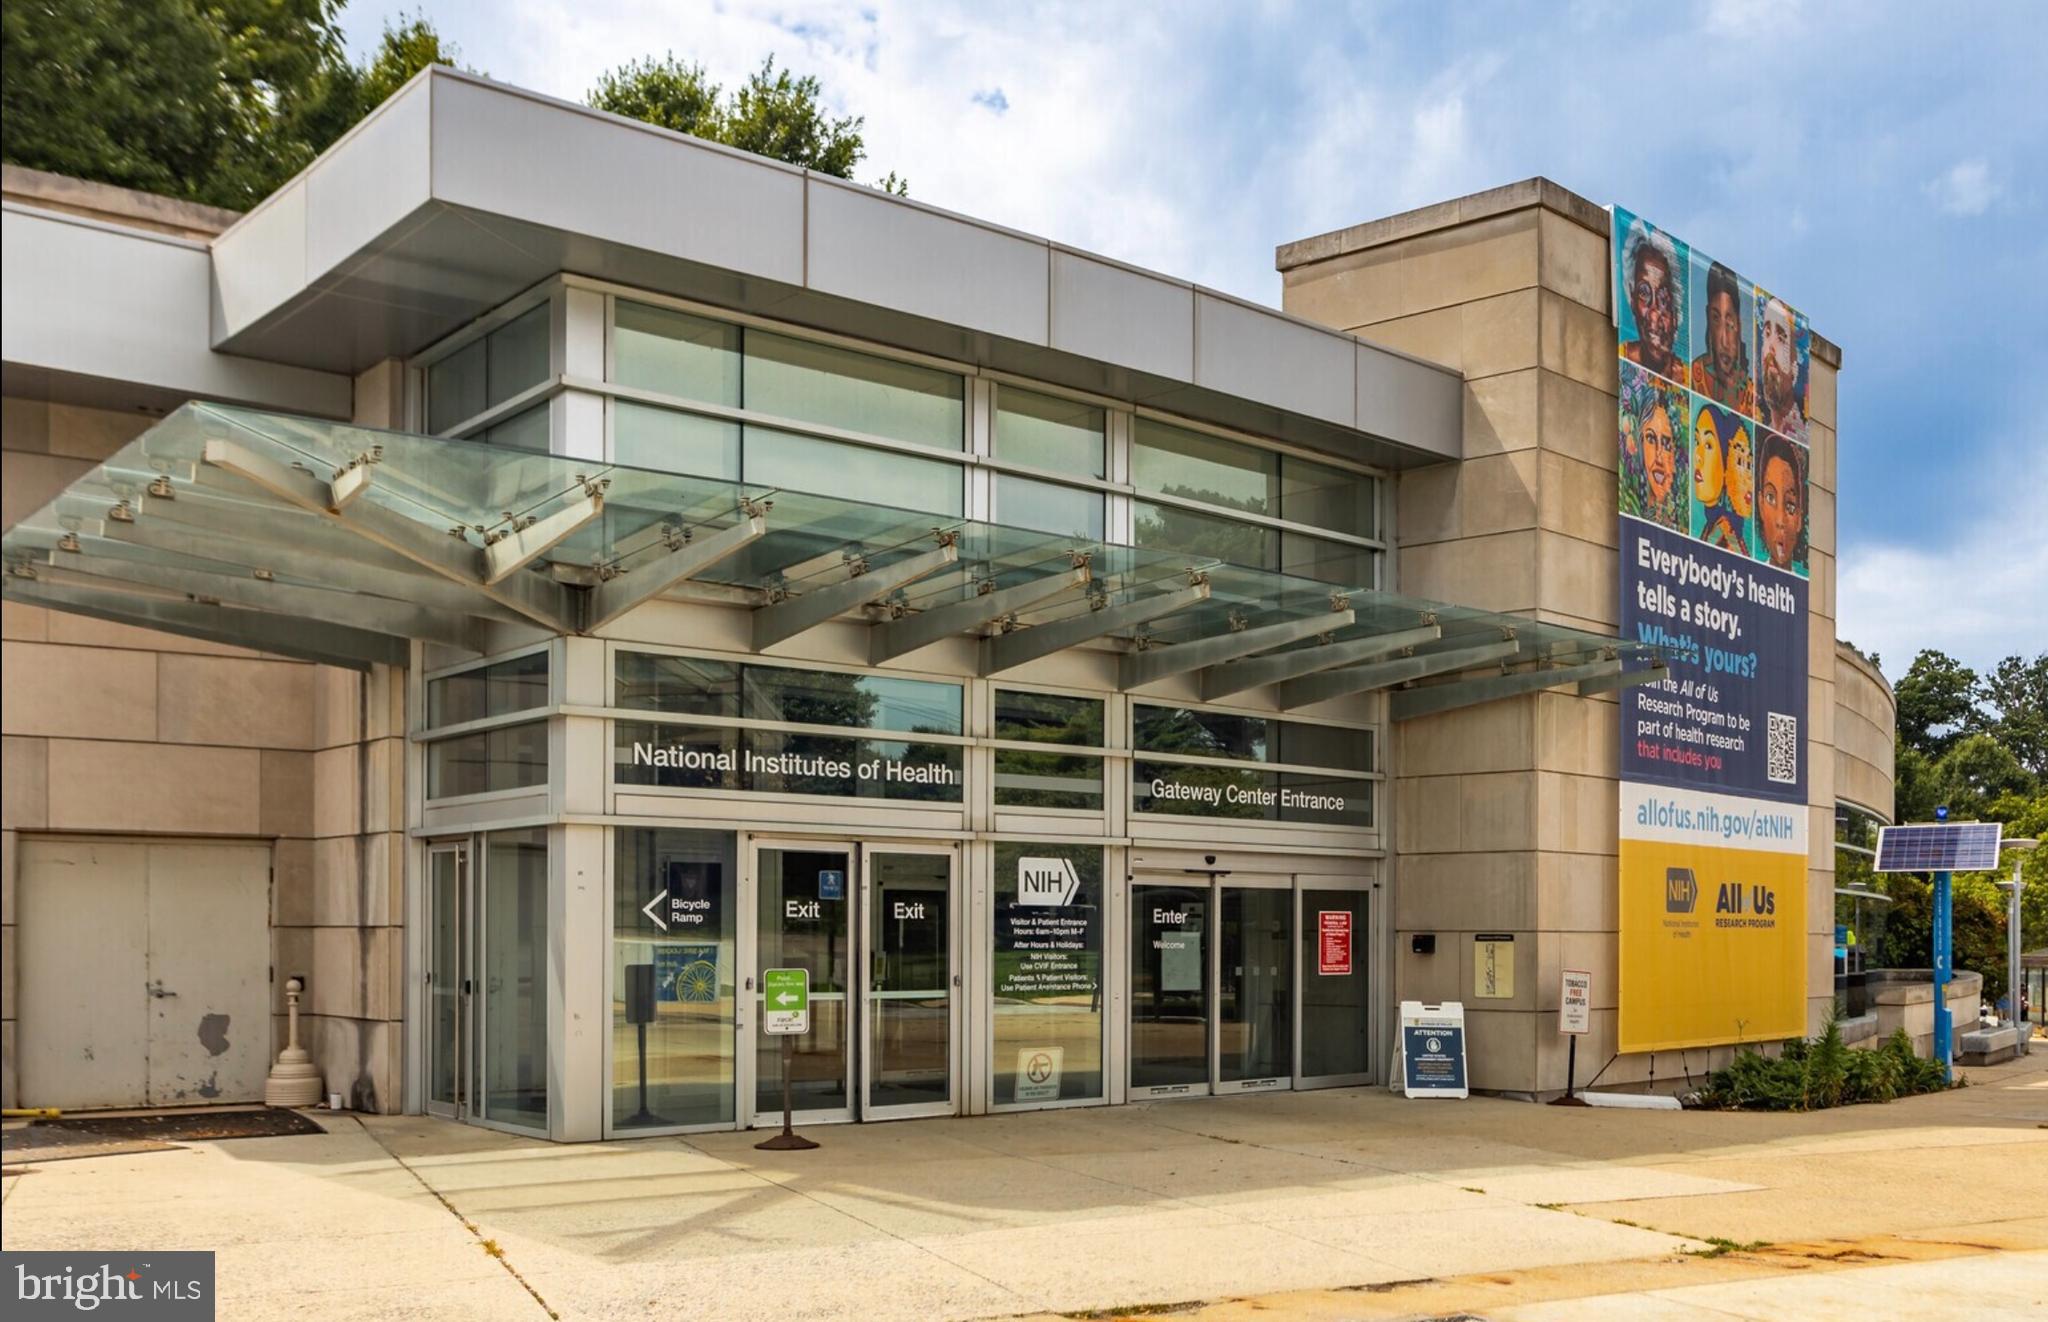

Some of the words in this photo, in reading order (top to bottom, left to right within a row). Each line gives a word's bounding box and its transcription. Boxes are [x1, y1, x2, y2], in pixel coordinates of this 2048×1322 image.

[1638, 537, 1745, 599] Everybody's
[1748, 574, 1795, 615] health
[1637, 580, 1676, 618] tells
[1680, 599, 1691, 622] a
[1695, 602, 1742, 640] story.
[1704, 646, 1757, 679] yours?
[1663, 678, 1678, 693] the
[1680, 679, 1695, 697] All
[1695, 684, 1706, 699] of
[1708, 685, 1719, 703] Us
[1638, 693, 1683, 718] Research
[1686, 703, 1725, 726] Program
[1727, 713, 1737, 729] to
[1739, 714, 1751, 731] be
[1638, 720, 1660, 736] part
[1663, 722, 1673, 738] of
[1675, 723, 1704, 745] health
[1706, 733, 1744, 752] research
[633, 742, 736, 772] National
[745, 750, 851, 778] Institutes
[857, 760, 880, 780] of
[886, 761, 954, 785] Health
[1637, 740, 1660, 760] that
[1663, 744, 1702, 767] includes
[1704, 755, 1722, 771] you
[1151, 779, 1222, 806] Gateway
[1226, 784, 1277, 806] Center
[1281, 789, 1344, 811] Entrance
[1637, 798, 1793, 840] allofus.nih.gov/atNIH
[1024, 870, 1062, 893] NIH
[1668, 879, 1690, 901] NIH
[671, 899, 710, 911] Bicycle
[785, 900, 821, 918] Exit
[1716, 883, 1742, 913] All
[1753, 885, 1775, 915] Us
[671, 912, 704, 924] Ramp
[894, 902, 925, 919] Exit
[1153, 908, 1188, 924] Enter
[1010, 918, 1030, 926] Visitor
[1031, 918, 1037, 926] &
[1038, 918, 1060, 926] Patient
[1060, 918, 1087, 926] Entrance
[1716, 918, 1747, 928] RESEARCH
[1748, 919, 1775, 928] PROGRAM
[1014, 941, 1029, 949] After
[1152, 940, 1185, 950] Welcome
[1038, 983, 1071, 991] Assistance
[1565, 979, 1587, 988] TOBACCO
[1569, 988, 1583, 997] FREE
[1565, 997, 1586, 1006] CAMPUS
